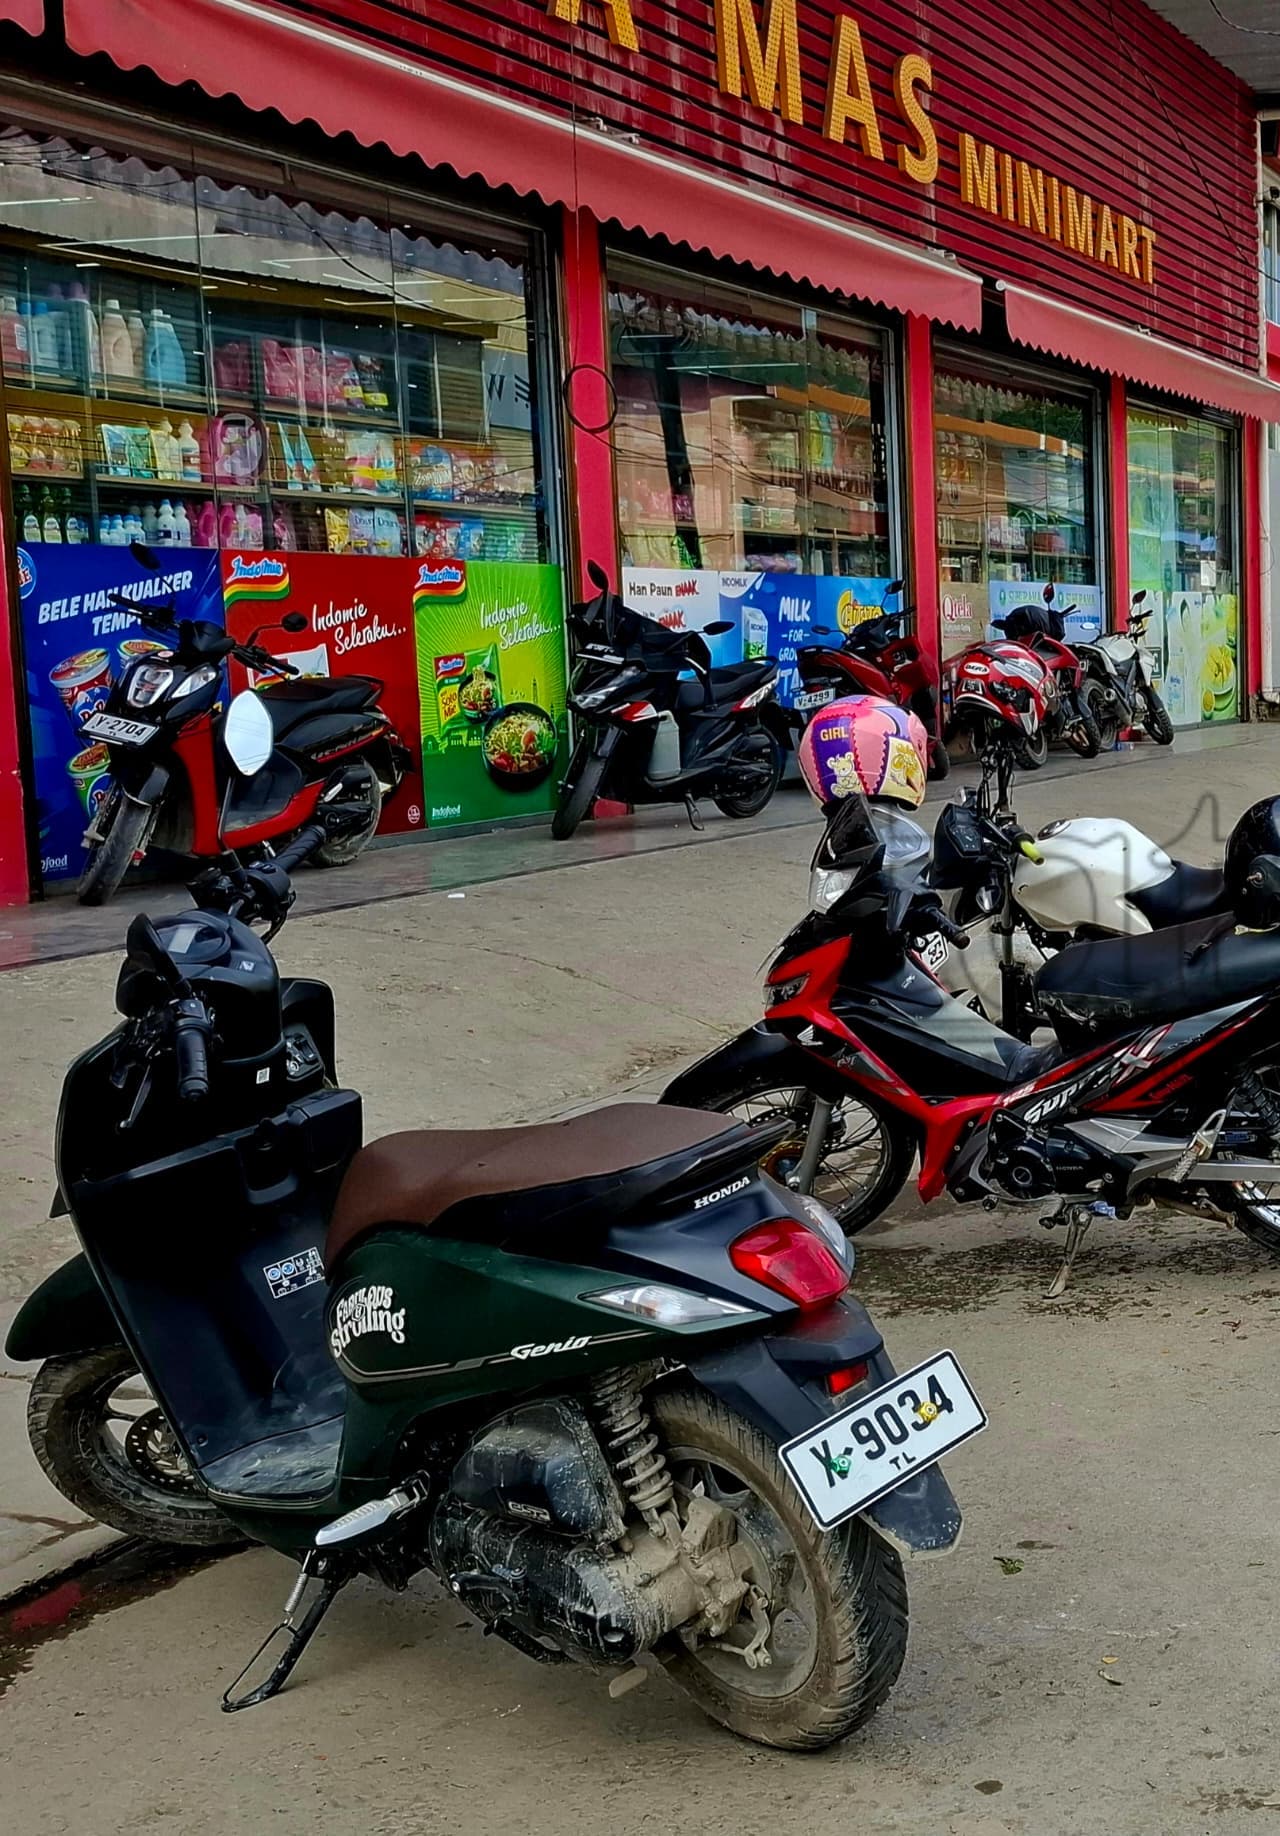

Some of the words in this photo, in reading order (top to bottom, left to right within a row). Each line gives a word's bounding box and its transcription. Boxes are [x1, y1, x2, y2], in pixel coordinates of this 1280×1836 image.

[714, 0, 938, 184] MAS
[958, 132, 1156, 285] MINIMART
[226, 555, 284, 584] Indomie
[414, 564, 463, 589] Indomie
[629, 581, 647, 596] Han
[649, 582, 673, 597] Paun
[38, 595, 81, 625] BELE
[312, 598, 367, 632] Indomie
[480, 597, 529, 630] Indomie
[778, 595, 811, 623] MILK
[943, 595, 973, 621] Qtela
[92, 613, 143, 636] TEMP
[820, 726, 849, 742] GIRL
[693, 1176, 750, 1210] HONDA
[510, 1335, 593, 1360] Genio
[889, 1451, 918, 1471] TL
